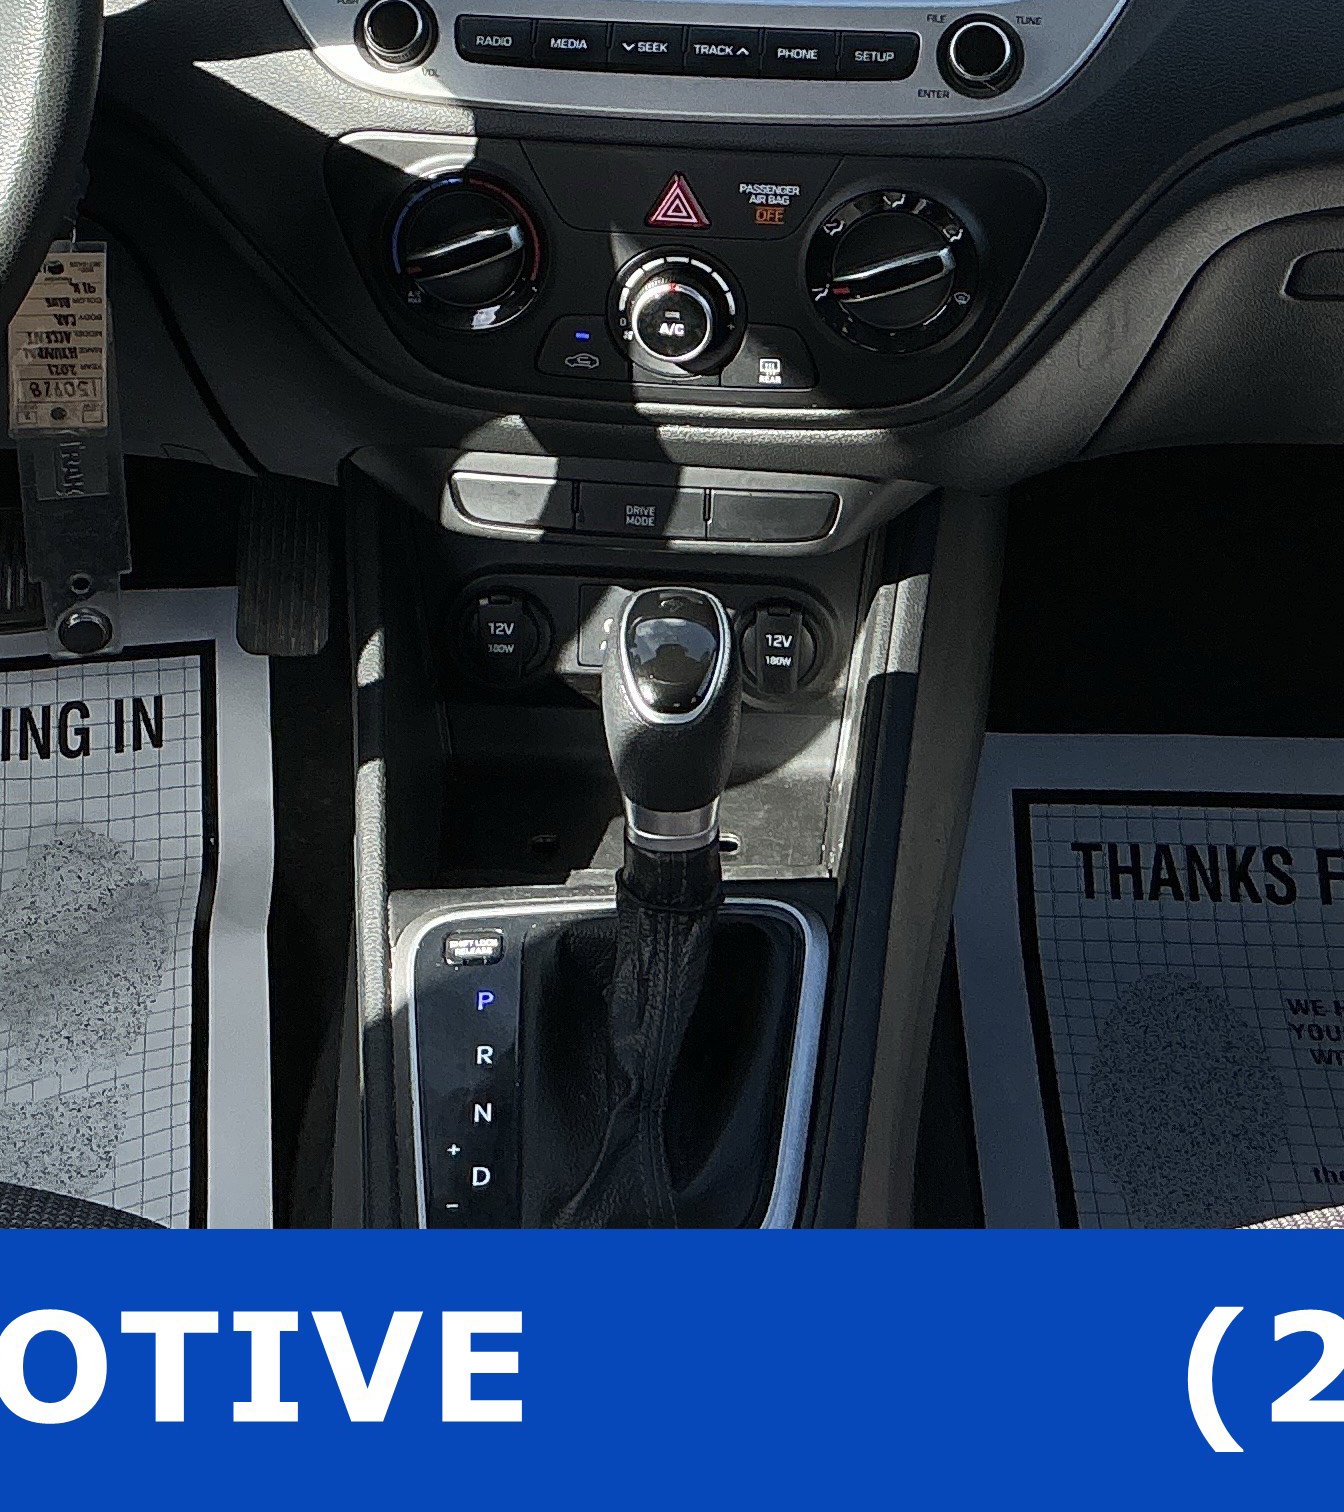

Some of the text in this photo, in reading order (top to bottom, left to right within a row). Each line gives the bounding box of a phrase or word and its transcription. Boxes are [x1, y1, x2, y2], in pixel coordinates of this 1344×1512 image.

[1016, 15, 1043, 26] TUNE
[476, 34, 513, 48] RADIO
[550, 36, 588, 51] MEDIA
[637, 40, 668, 55] SEEK
[693, 42, 734, 57] TRACK
[776, 46, 819, 61] PHONE
[854, 49, 896, 64] SETUP
[917, 88, 951, 99] ENTER
[739, 183, 801, 195] PASSENGER
[748, 194, 790, 206] AIR BAG
[755, 208, 785, 222] OFF
[658, 322, 686, 337] A/C
[46, 363, 78, 377] 2021
[758, 375, 782, 385] REAR
[626, 504, 656, 517] DRIVE
[626, 515, 656, 527] MODE
[487, 621, 515, 636] 12V
[765, 633, 793, 648] 12V
[114, 694, 166, 754] IN
[1070, 841, 1299, 906] THANKS
[476, 991, 495, 1011] P
[1287, 998, 1326, 1017] WE
[475, 1045, 494, 1065] R
[473, 1102, 493, 1123] N
[471, 1166, 491, 1187] D
